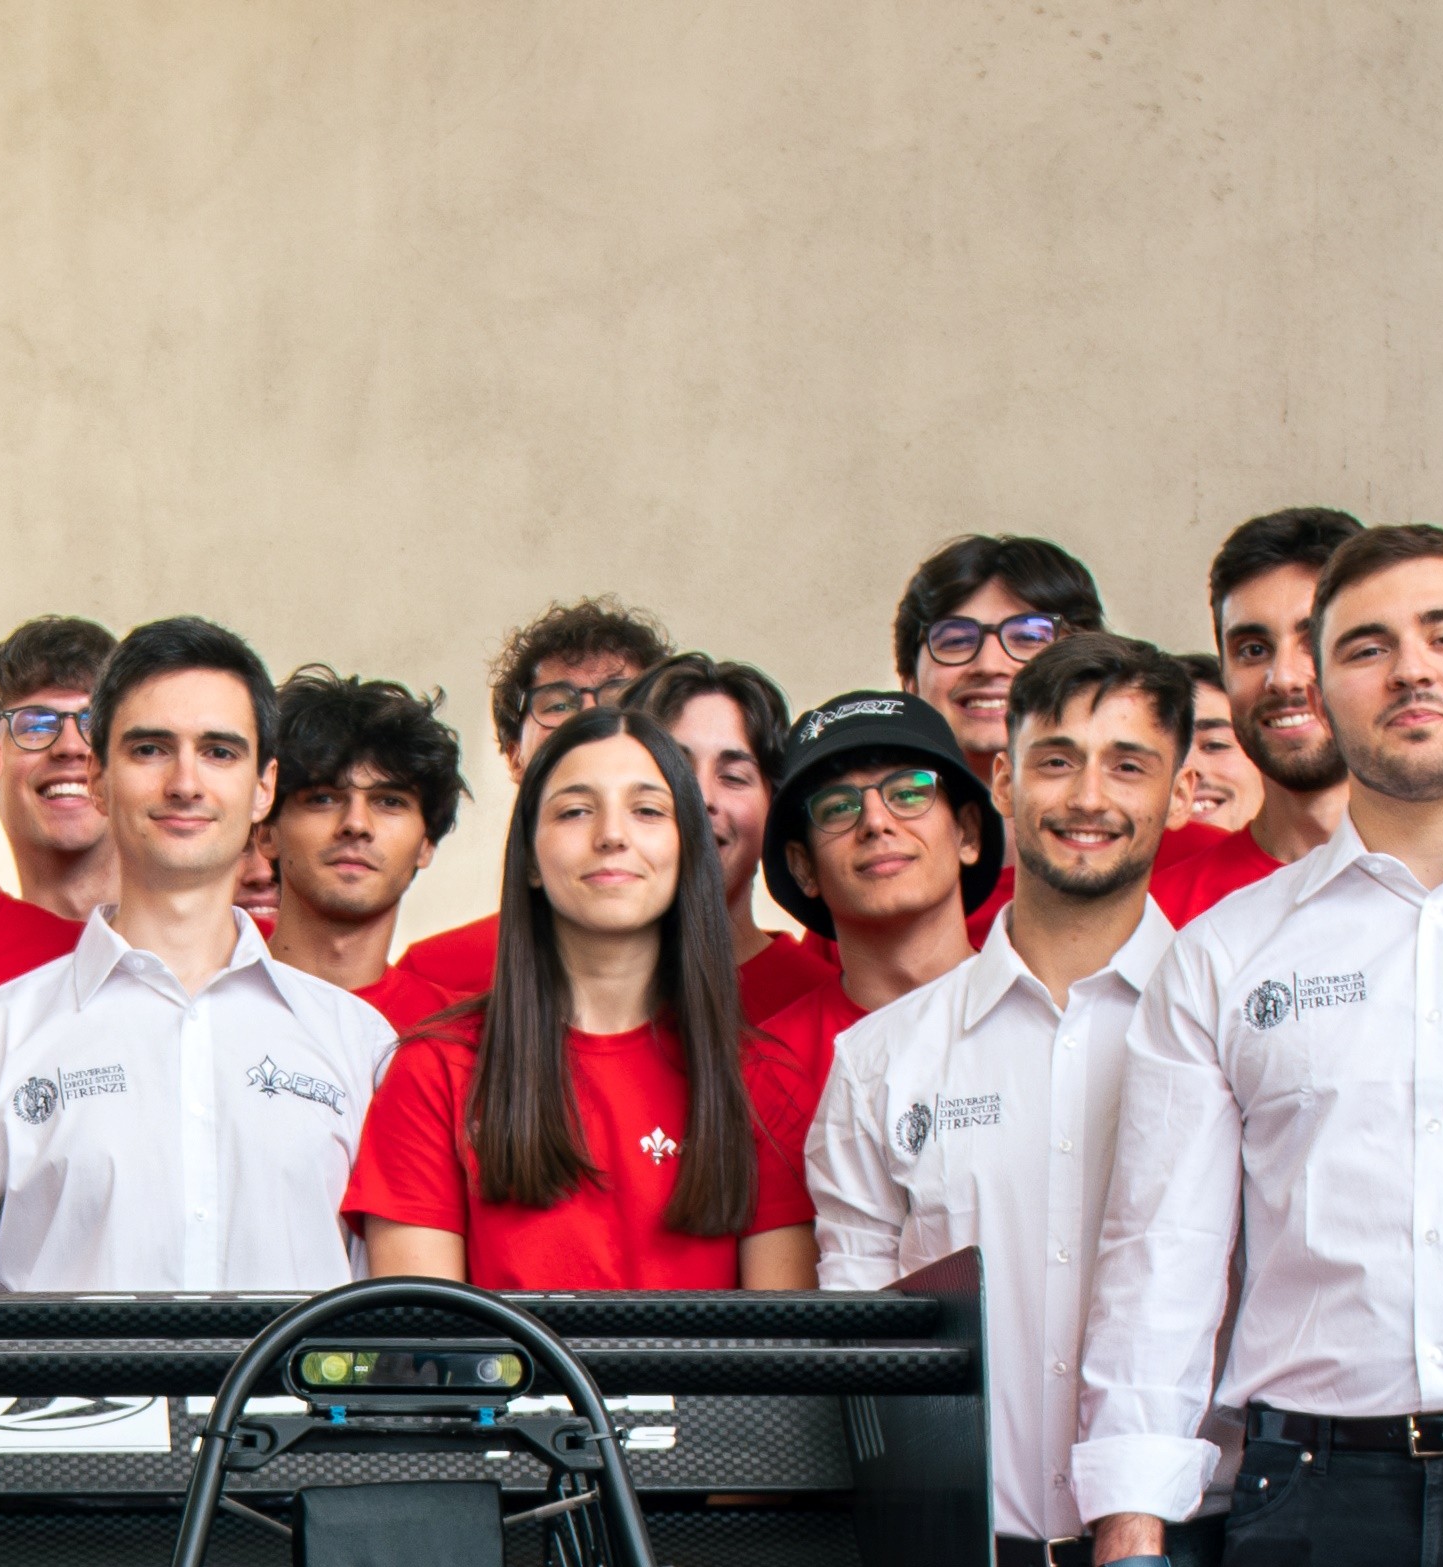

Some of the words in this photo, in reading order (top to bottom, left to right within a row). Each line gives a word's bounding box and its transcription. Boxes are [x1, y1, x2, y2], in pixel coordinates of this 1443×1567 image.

[1299, 970, 1364, 987] UNIVERSITÀ
[1300, 985, 1330, 997] DEGLI
[1332, 982, 1365, 994] STUDI
[1301, 992, 1367, 1010] FIRENZE
[63, 1065, 124, 1081] UNIVERSITÀ
[64, 1077, 93, 1089] DEGLI
[95, 1074, 125, 1085] STUDI
[66, 1083, 127, 1100] FIRENZE
[940, 1092, 1001, 1109] UNIVERSITÀ
[940, 1107, 969, 1118] DEGLI
[971, 1105, 1001, 1115] STUDI
[939, 1114, 1001, 1130] FIRENZE
